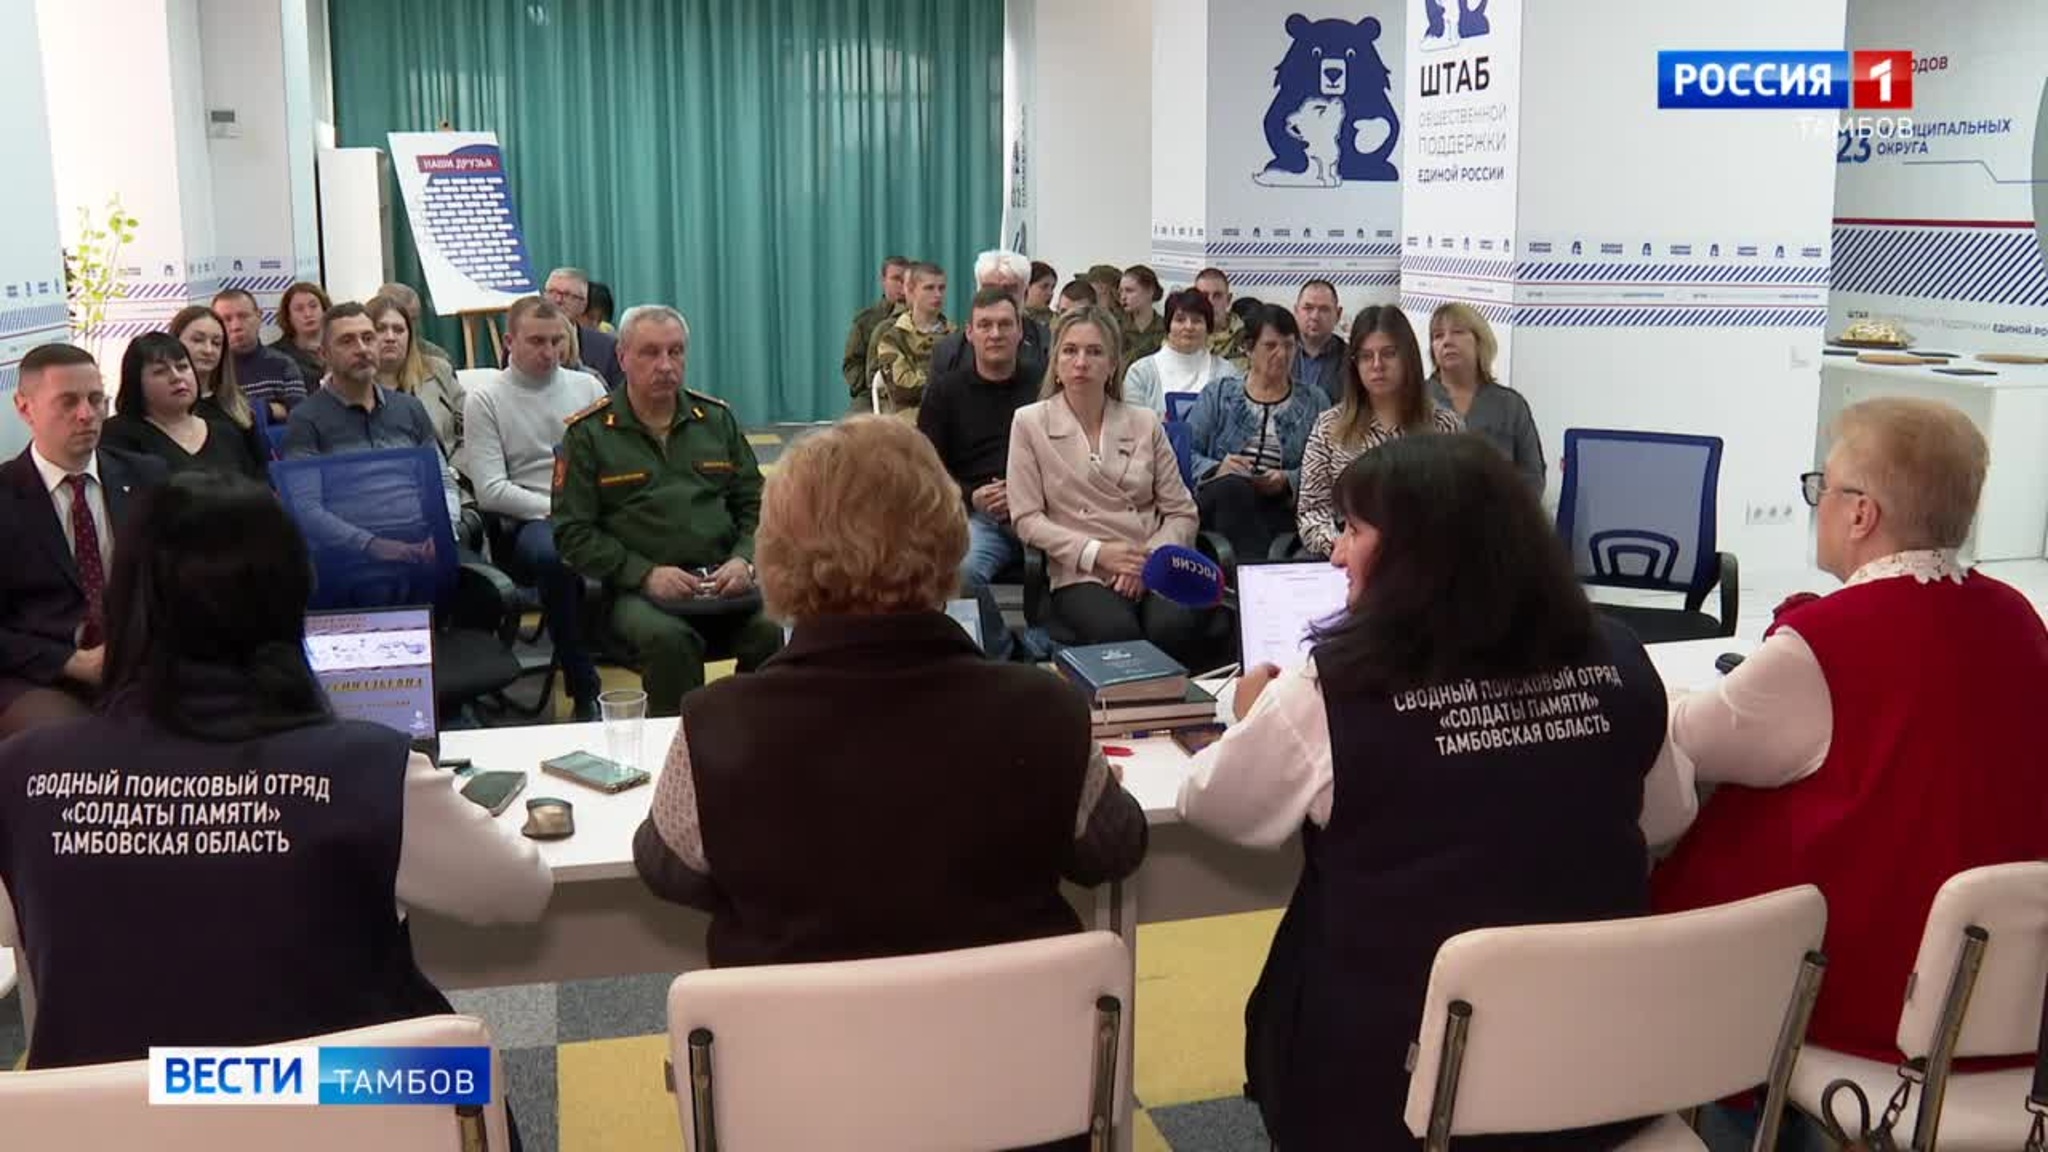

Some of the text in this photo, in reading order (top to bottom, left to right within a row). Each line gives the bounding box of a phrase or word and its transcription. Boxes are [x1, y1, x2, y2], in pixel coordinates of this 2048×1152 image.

[1420, 56, 1490, 97] ШТАБ
[1911, 56, 1948, 74] ОДОВ
[1879, 119, 2011, 138] МУИЦИПАЛЬНЫХ
[1419, 132, 1507, 156] ПОДДЕРЖКИ
[1877, 141, 1928, 155] ОКРУГА
[1418, 164, 1504, 183] ЕДИНОЙ РОССИИ
[1172, 556, 1217, 581] РОССИЯ
[1393, 665, 1624, 712] СВОДНЫЙ ПОИСКОВЫЙ ОТРЯД
[1439, 691, 1599, 730] «СОЛДАТЫ ПАМЯТИ»
[1435, 714, 1611, 756] ТАМБОВСКАЯ ОБЛАСТЬ
[27, 769, 331, 804] СВОДНЫЙ ПОИСКОВЫЙ ОТРЯД
[61, 801, 281, 829] «СОЛДАТЫ ПАМЯТИ»
[52, 829, 290, 855] ТАМБОВСКАЯ ОБЛАСТЬ
